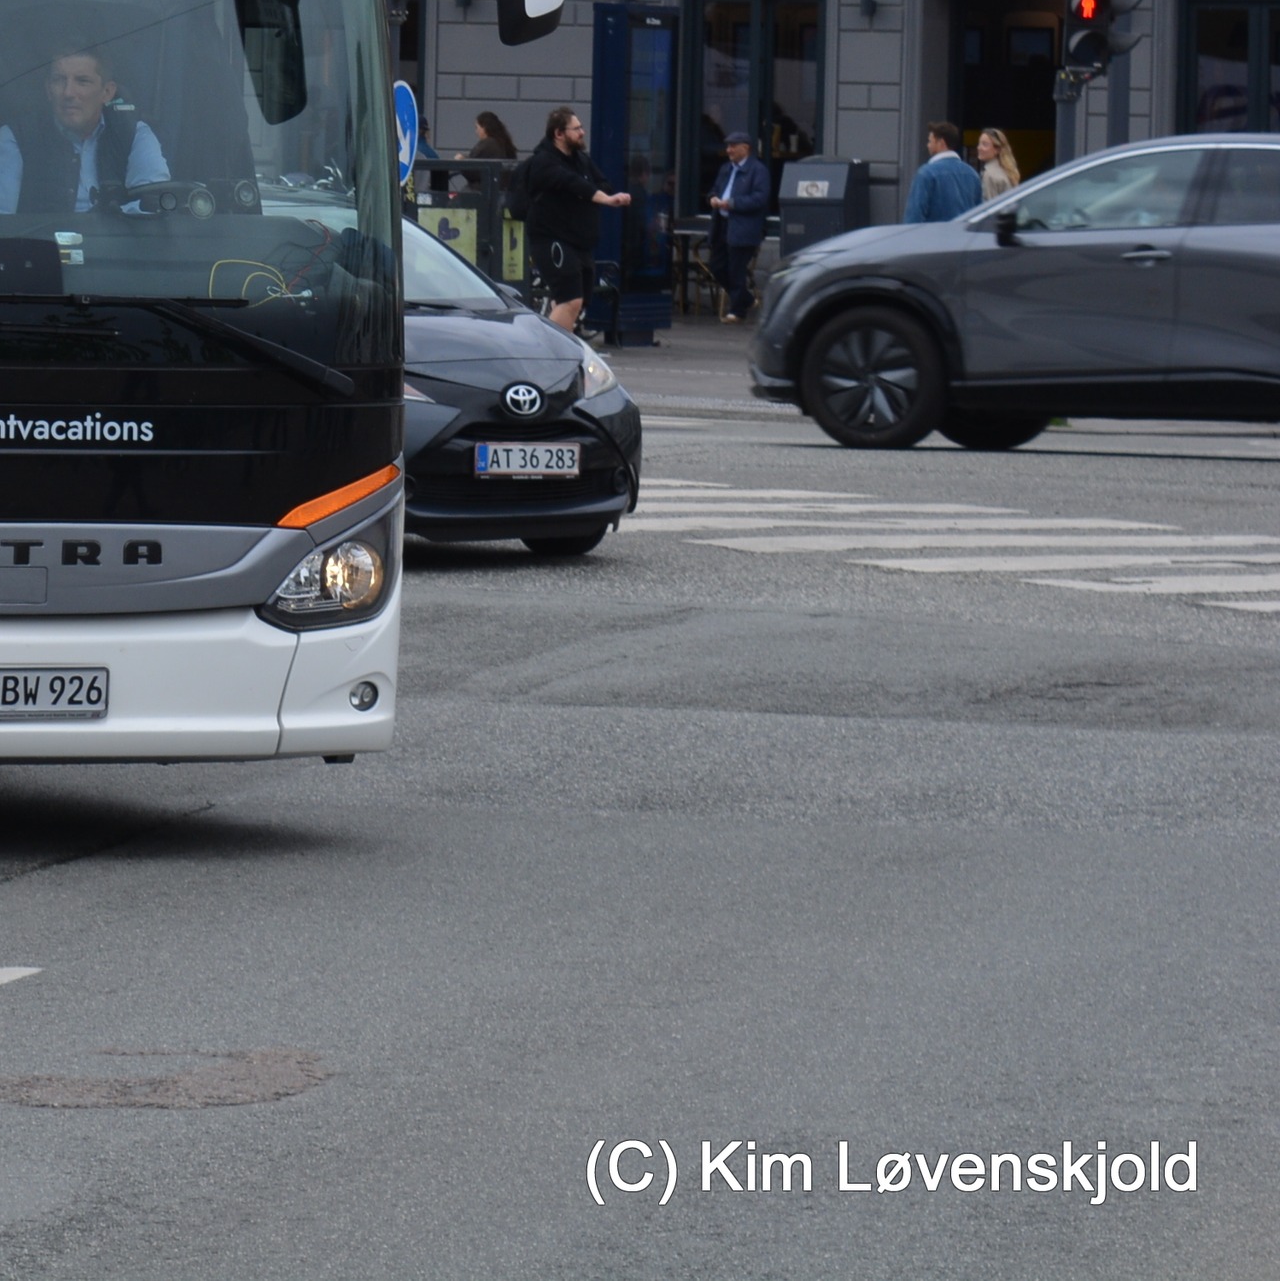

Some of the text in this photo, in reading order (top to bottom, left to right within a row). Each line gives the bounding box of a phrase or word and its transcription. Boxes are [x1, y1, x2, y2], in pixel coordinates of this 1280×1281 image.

[490, 448, 576, 469] AT 36 283
[1, 676, 40, 706] BW
[49, 675, 103, 706] 926
